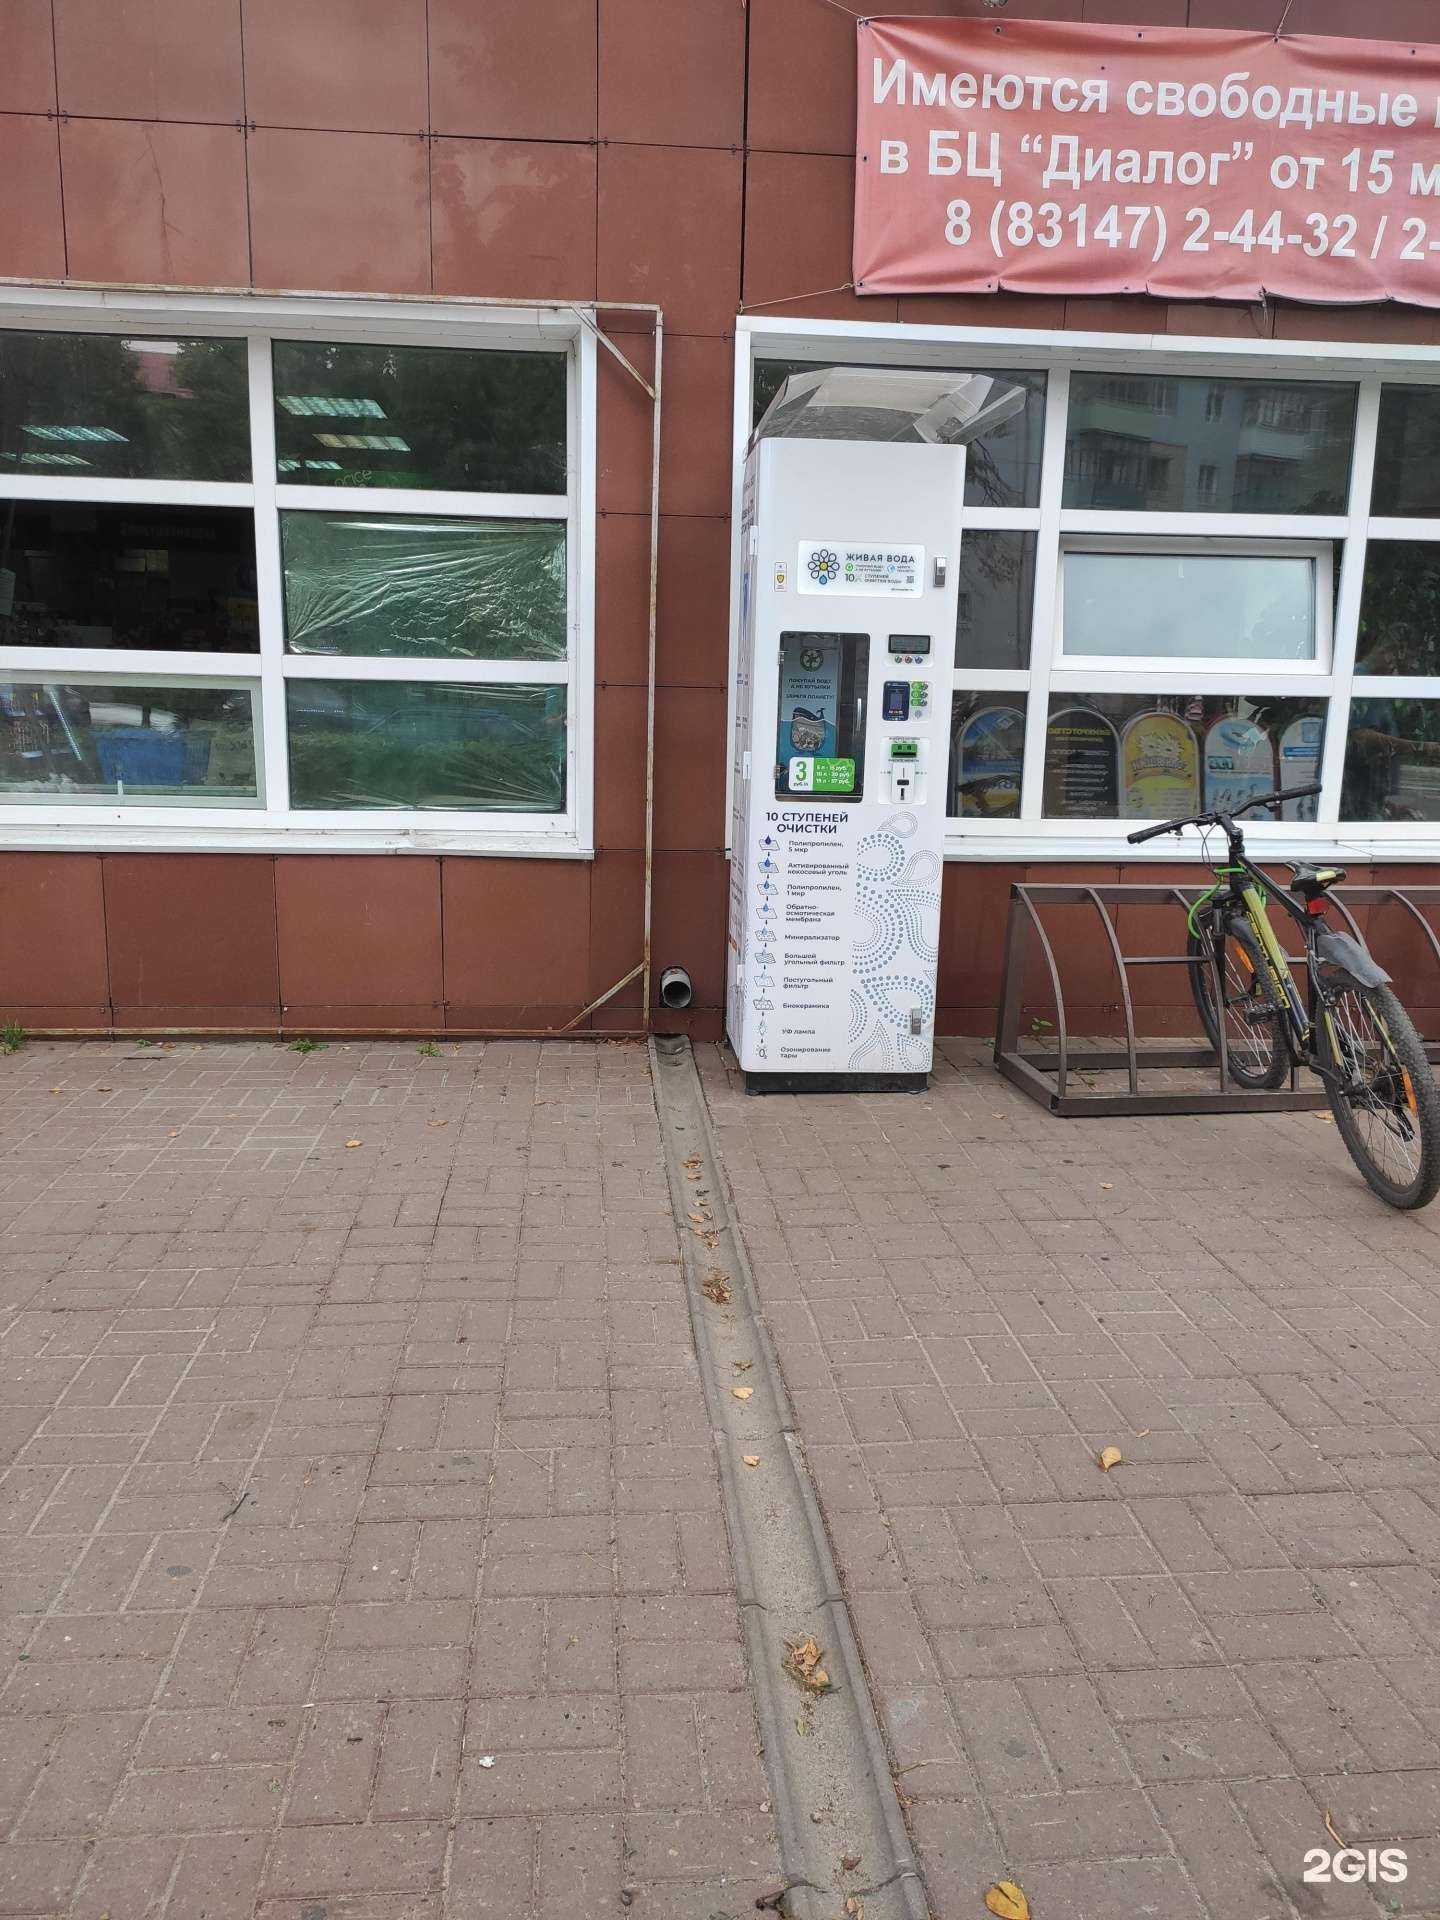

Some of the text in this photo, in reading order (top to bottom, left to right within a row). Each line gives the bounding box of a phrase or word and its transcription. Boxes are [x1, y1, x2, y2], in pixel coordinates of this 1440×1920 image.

[873, 57, 1108, 113] Имеются
[1127, 72, 1417, 129] свободные
[880, 139, 909, 175] в
[928, 130, 1002, 187] БЦ
[1020, 134, 1254, 190] “Диалог”
[1270, 154, 1324, 190] от
[1340, 148, 1394, 194] 15
[945, 200, 972, 246] 8
[990, 200, 1167, 262] (83147)
[1183, 207, 1357, 260] 2-44-32
[1370, 215, 1388, 260] /
[846, 553, 915, 564] ЖИВАЯ ВОДА
[845, 573, 855, 582] 10
[795, 761, 807, 781] 3
[766, 811, 849, 823] 10 СТУПЕНЕЙ
[777, 823, 837, 834] ОЧИСТКИ
[788, 840, 844, 848] Полипропилен,
[784, 934, 841, 942] Минерализатор
[783, 1002, 830, 1010] Биокерамика
